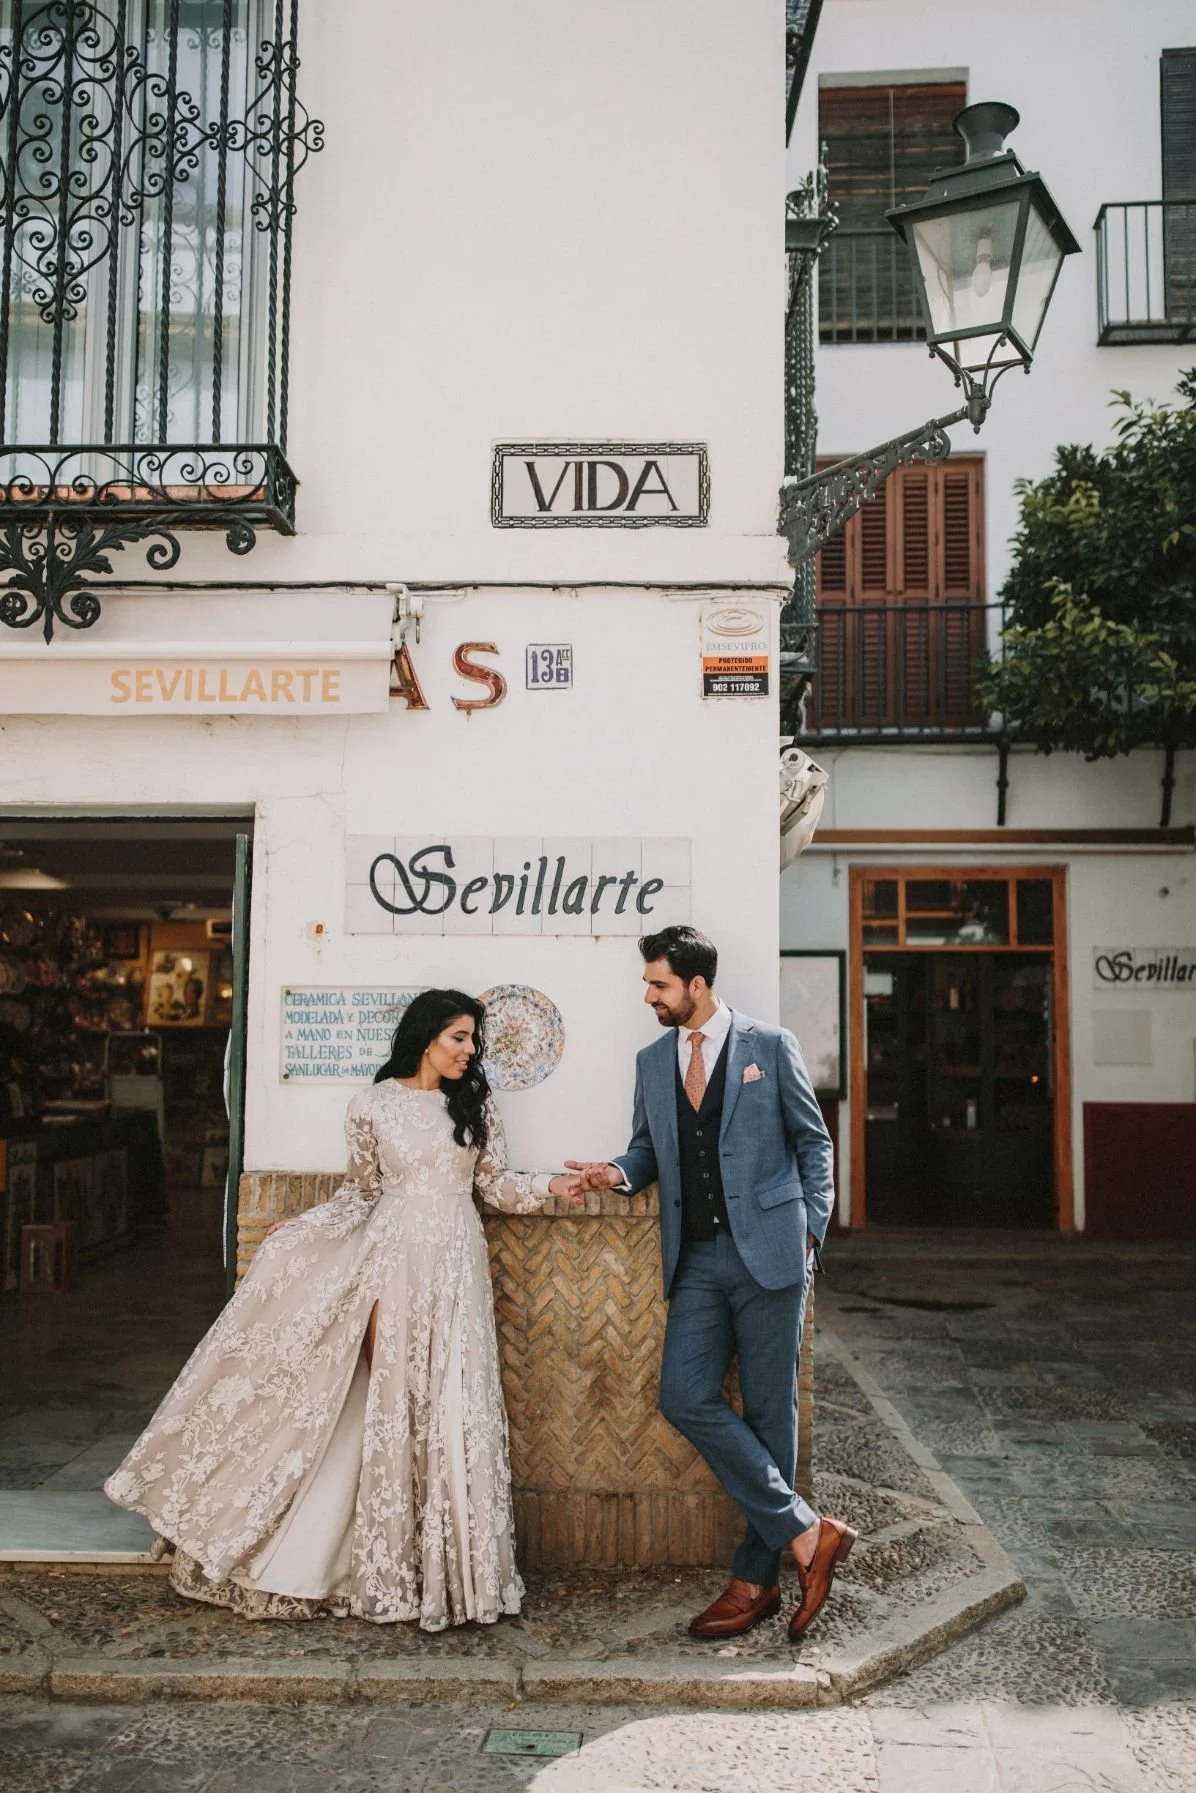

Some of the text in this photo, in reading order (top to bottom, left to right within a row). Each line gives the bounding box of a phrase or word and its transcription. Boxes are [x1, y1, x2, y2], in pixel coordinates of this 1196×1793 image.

[523, 460, 680, 512] VIDA
[706, 641, 766, 651] EMSEVIPRO
[531, 649, 554, 683] 13
[110, 668, 341, 704] SEVILLARTE
[712, 683, 760, 691] 902 117092
[369, 844, 664, 915] Sevillarte
[284, 992, 346, 1008] CERAMICA
[284, 1009, 344, 1025] MODELADA
[285, 1030, 293, 1039] A
[297, 1028, 331, 1041] MANO
[336, 1030, 353, 1041] EN
[285, 1045, 373, 1061] TALLERES DE
[285, 1063, 343, 1077] SANLUGAR
